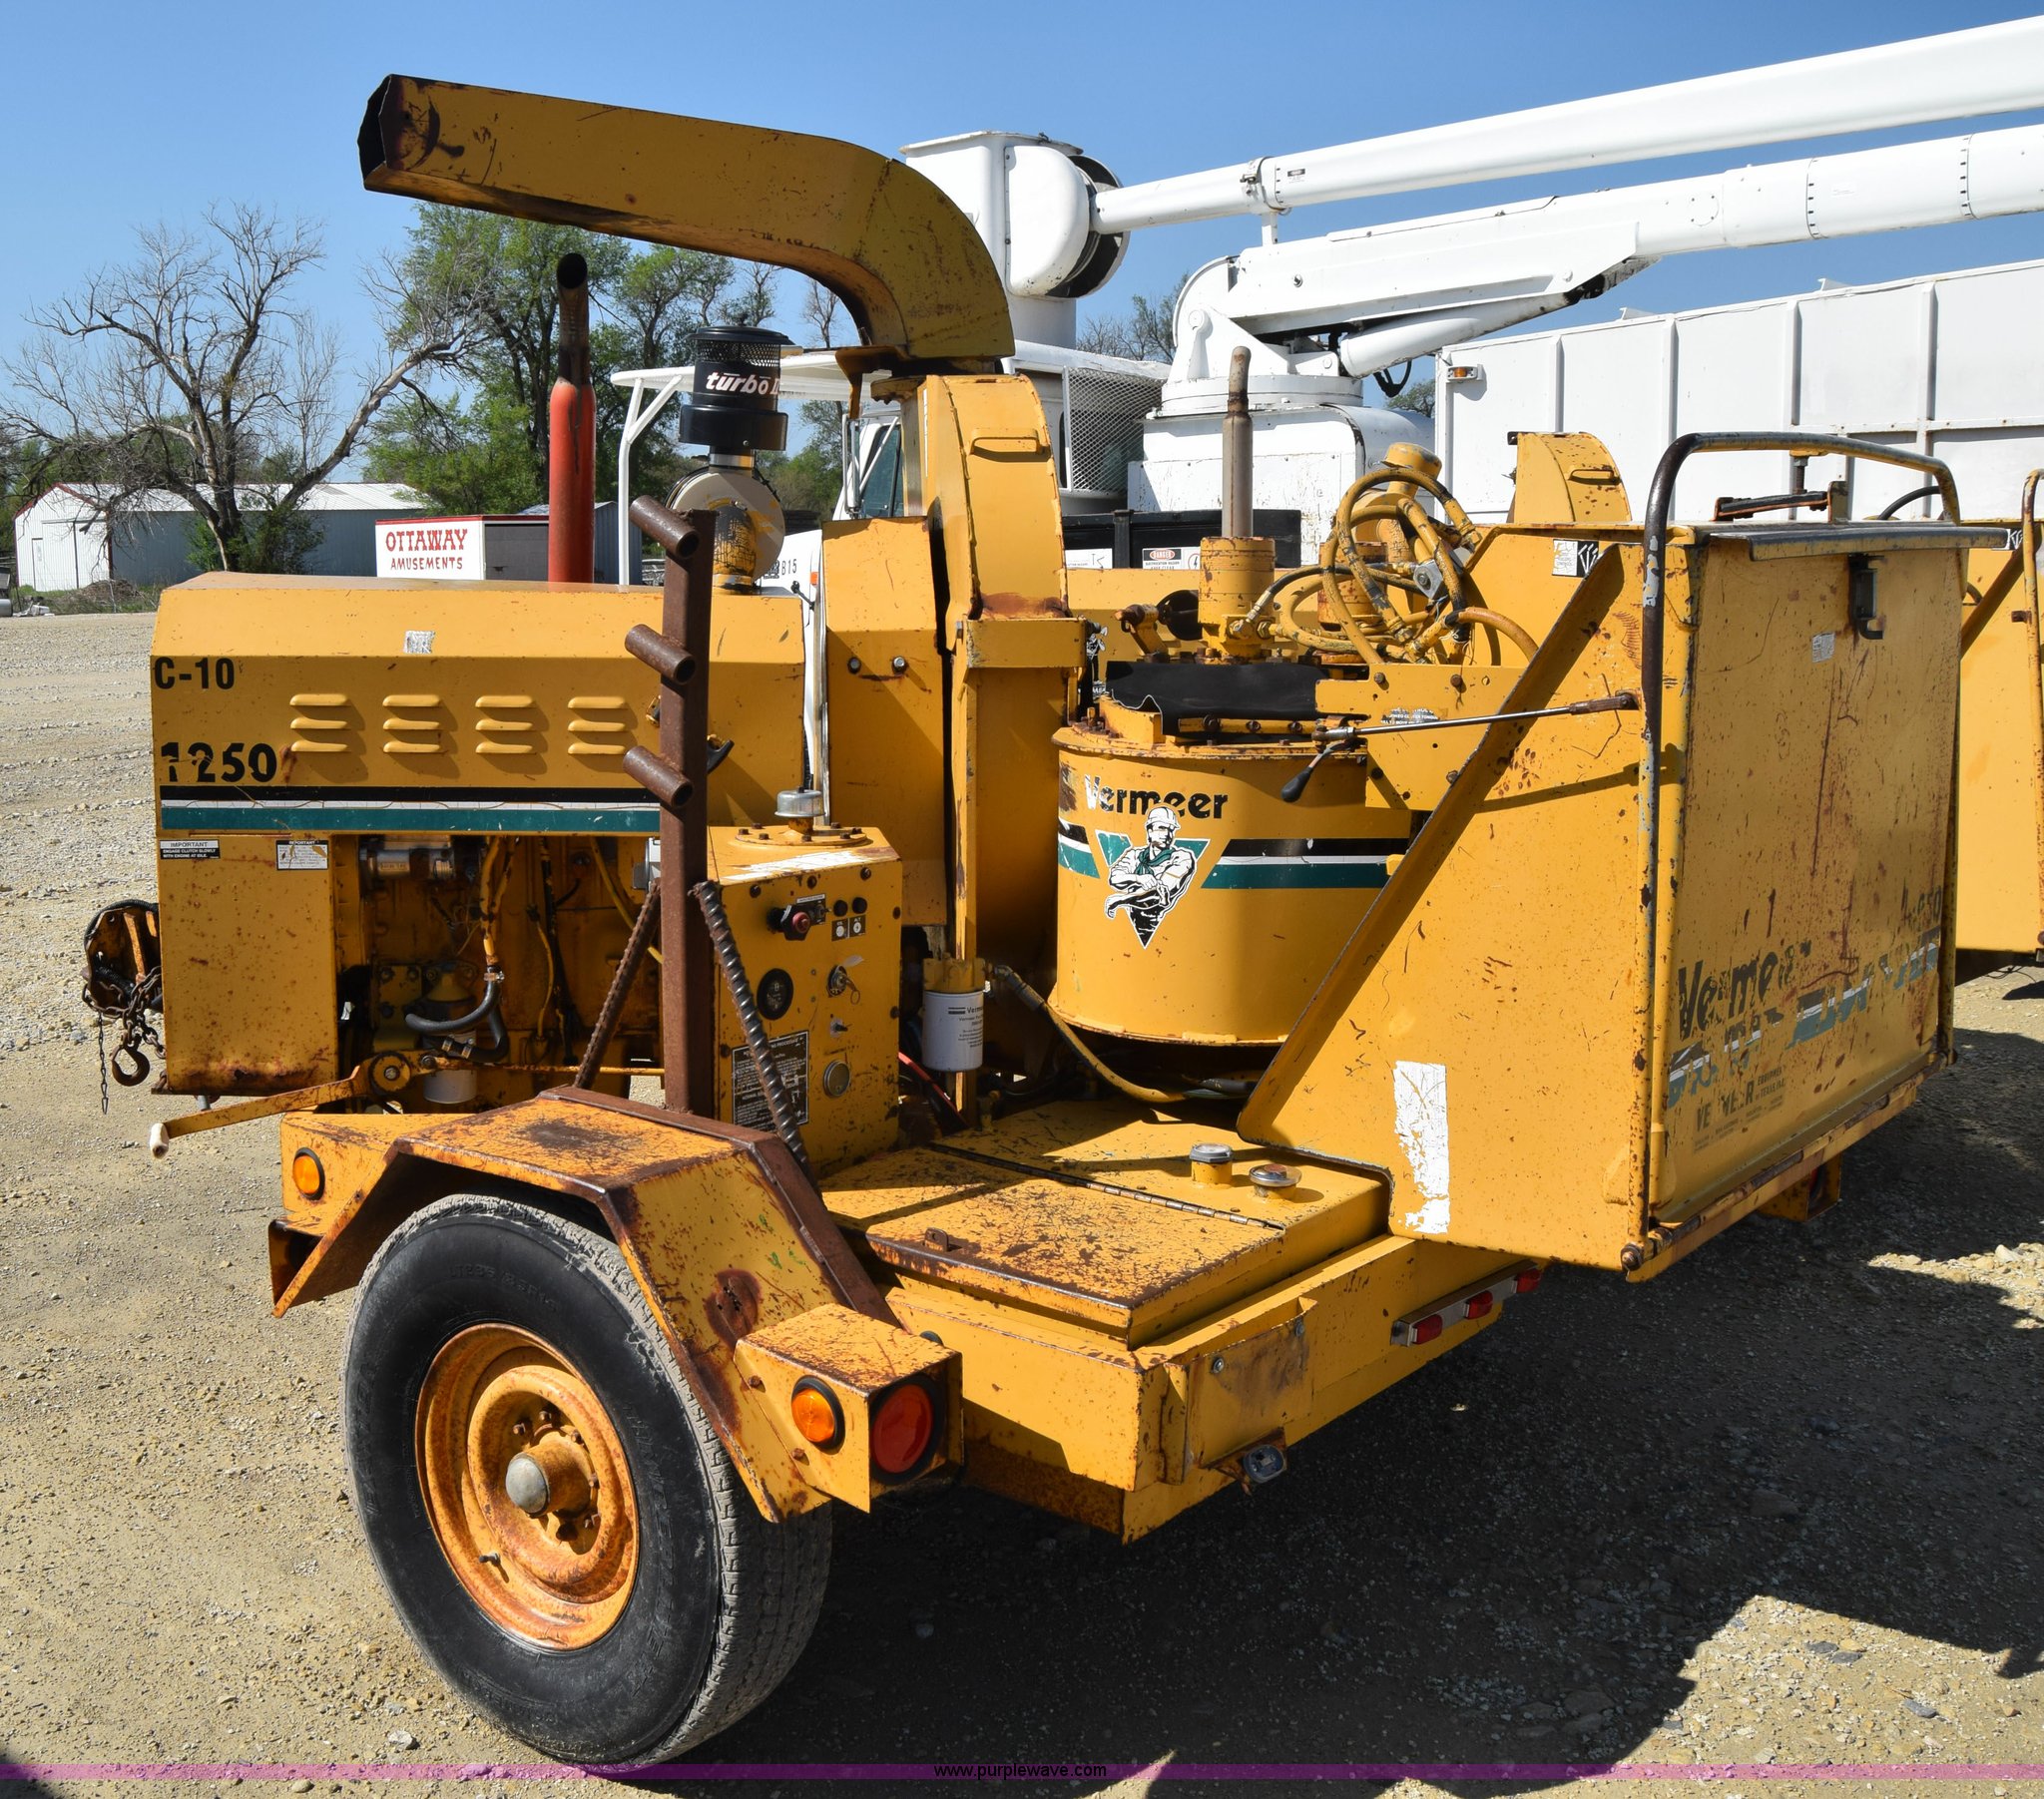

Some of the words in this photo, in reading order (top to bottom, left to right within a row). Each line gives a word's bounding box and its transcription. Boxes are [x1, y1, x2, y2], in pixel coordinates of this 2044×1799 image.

[386, 529, 468, 552] OTTAWAY
[390, 557, 463, 570] AMUSEMENTS
[781, 559, 797, 575] B15
[155, 657, 235, 689] C-10
[161, 742, 277, 783] 1250
[1084, 774, 1229, 819] Vermeer
[1678, 939, 1811, 1042] Veme
[1757, 1066, 1784, 1087] EQUIPMEN
